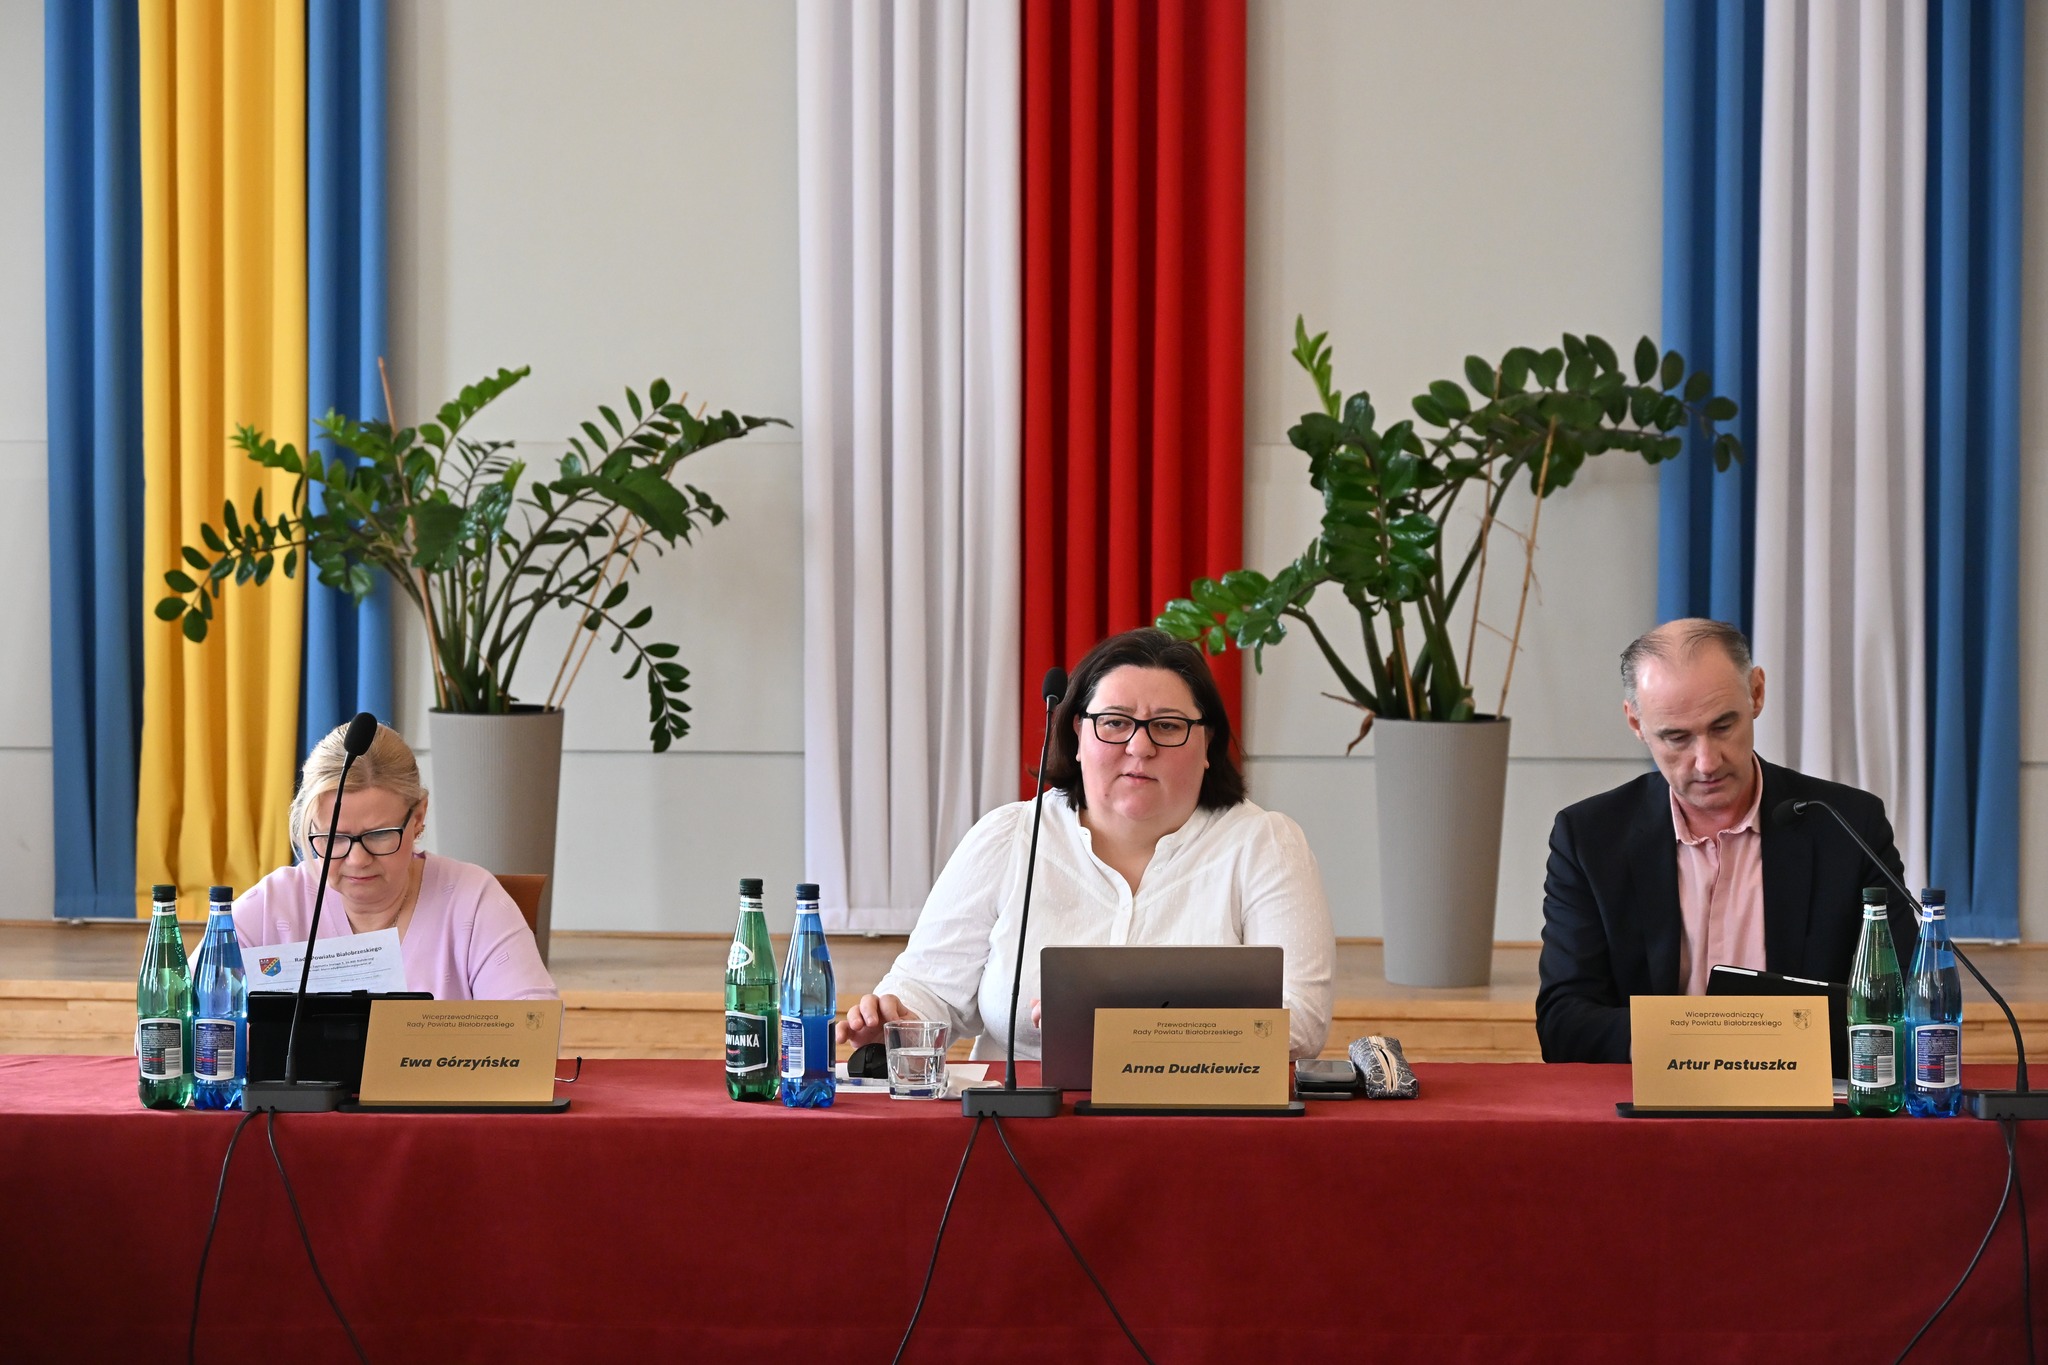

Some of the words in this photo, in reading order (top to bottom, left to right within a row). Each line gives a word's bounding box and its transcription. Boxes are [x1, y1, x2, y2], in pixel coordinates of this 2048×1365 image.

[336, 946, 383, 958] Białobrzeskiego
[421, 1013, 499, 1022] Wiceprzewodnicząca
[1685, 1011, 1764, 1020] Wiceprzewodniczący
[406, 1021, 425, 1029] Rady
[458, 1021, 515, 1029] Białobrzeskiego
[1157, 1021, 1217, 1030] Przewodnicząca
[1670, 1019, 1689, 1028] Rady
[1691, 1019, 1722, 1027] Powiatu
[1723, 1019, 1783, 1028] Białobrzeskiego
[1133, 1028, 1152, 1037] Rady
[1153, 1028, 1184, 1036] Powiatu
[1185, 1028, 1243, 1037] Białobrzeskiego
[400, 1057, 433, 1068] Ewa
[436, 1056, 520, 1071] Górzyńska
[1122, 1063, 1164, 1074] Anna
[1168, 1062, 1261, 1074] Dudkiewicz
[1667, 1059, 1711, 1071] Artur
[1714, 1059, 1797, 1071] Pastuszka
